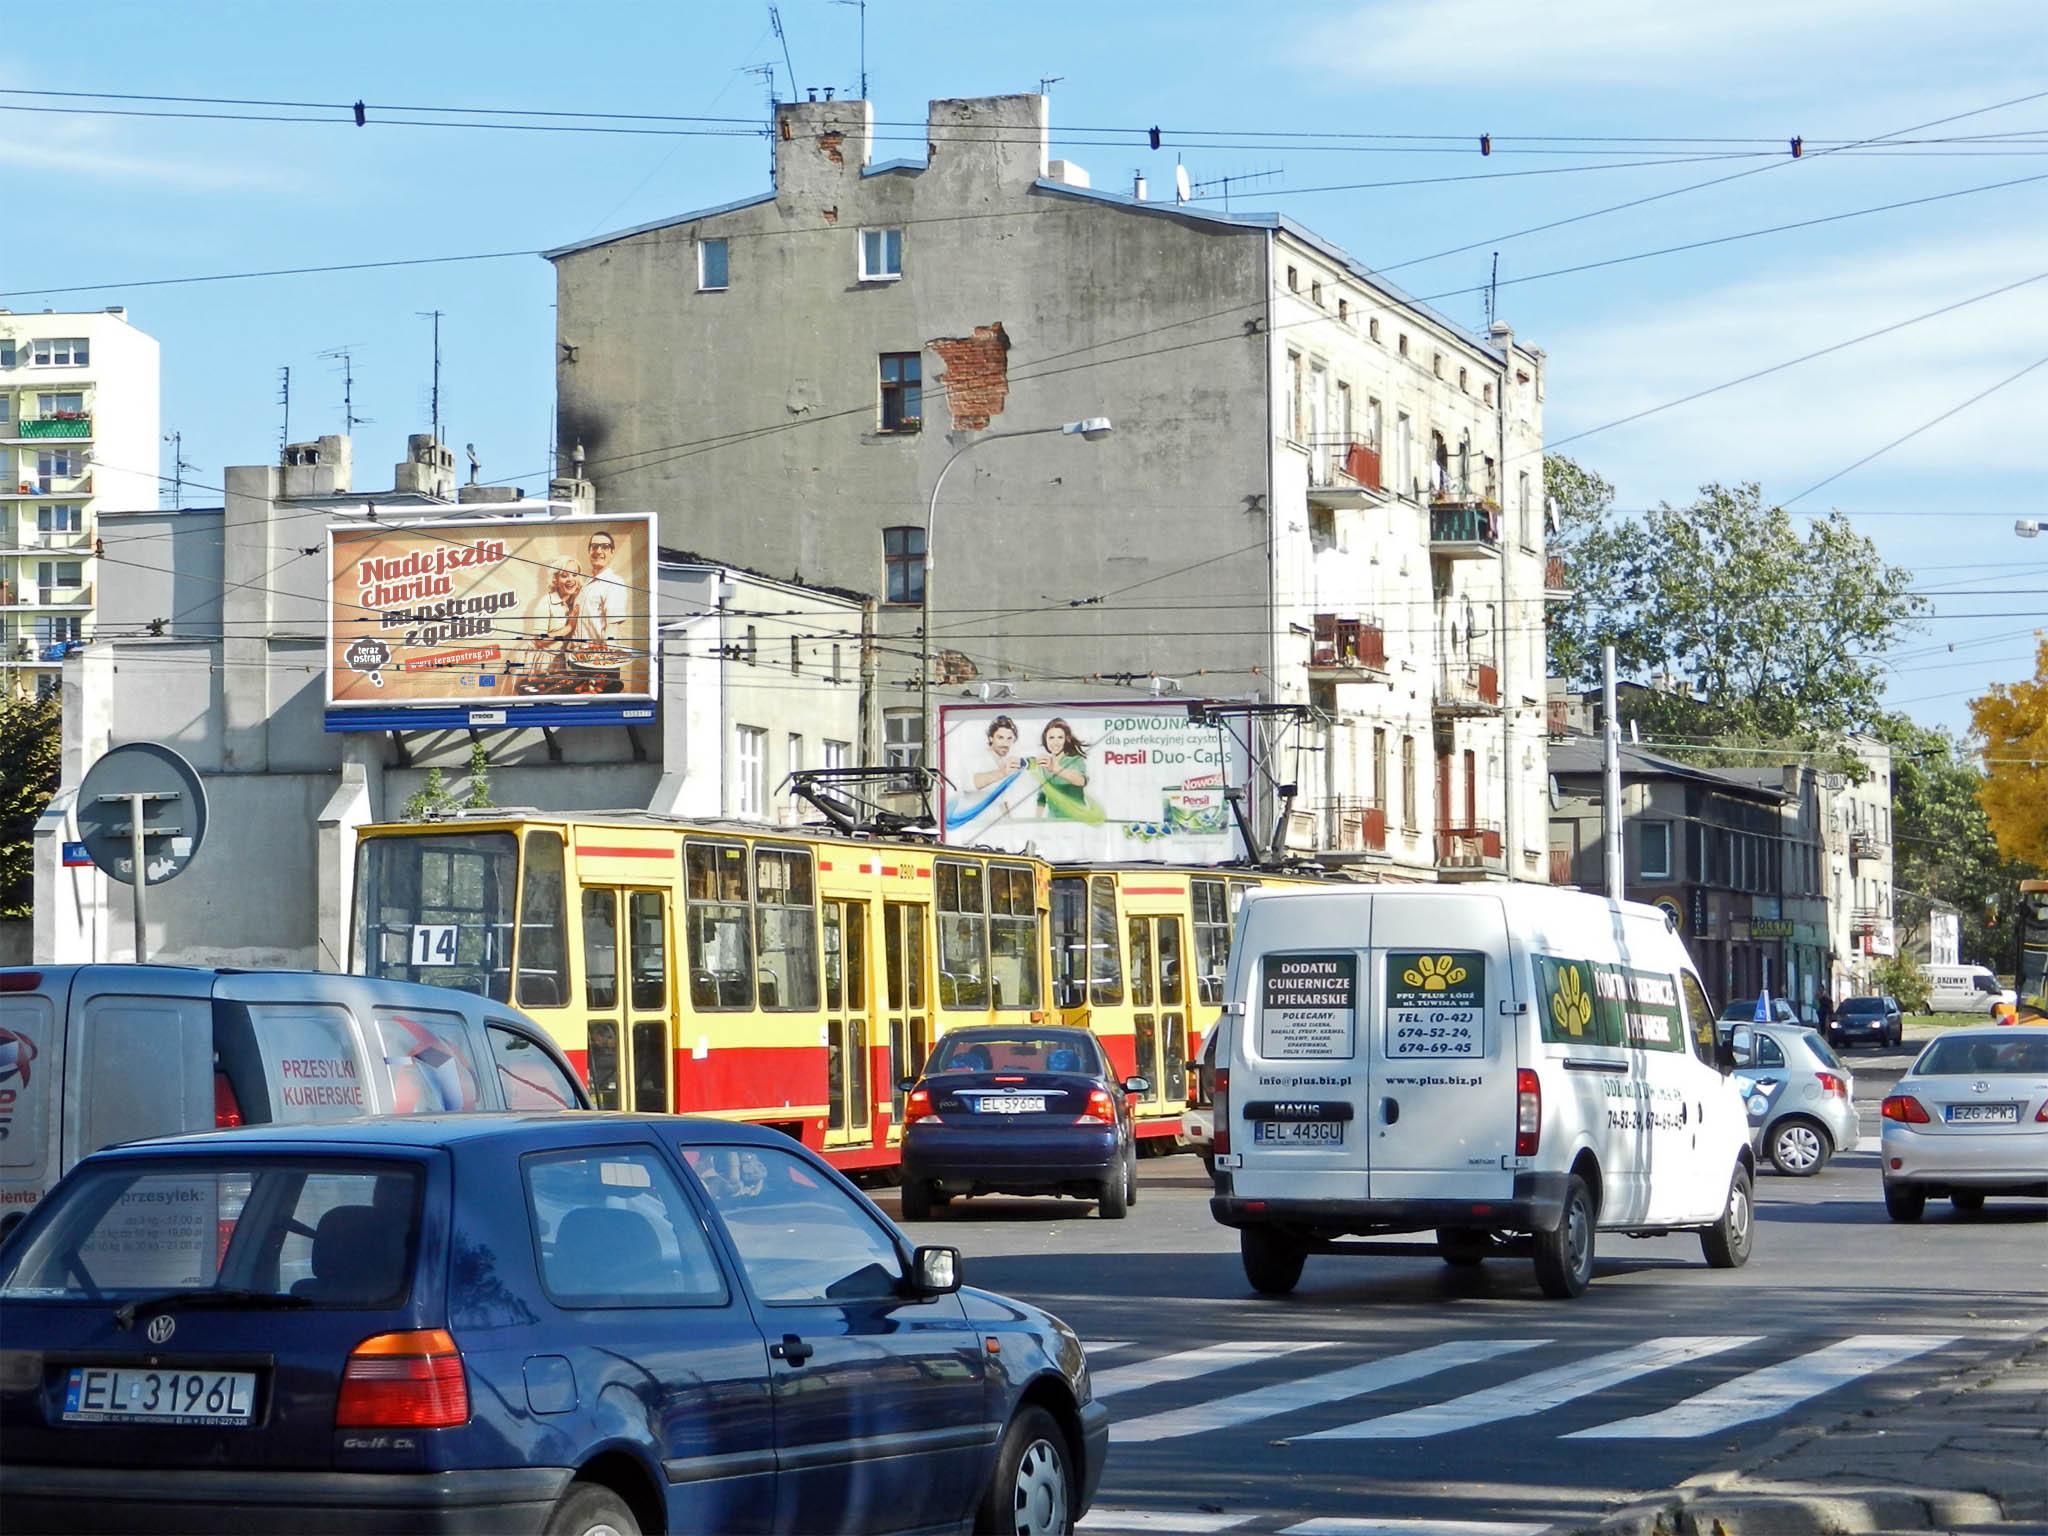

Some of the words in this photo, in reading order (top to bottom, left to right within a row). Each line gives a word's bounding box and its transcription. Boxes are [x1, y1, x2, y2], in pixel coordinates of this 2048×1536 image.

[359, 540, 505, 585] Nadejszła
[361, 575, 453, 608] chwila
[381, 607, 413, 629] na
[405, 629, 419, 646] z
[422, 612, 493, 646] grilla
[357, 646, 380, 655] teraz
[353, 653, 382, 665] pstrąg
[1104, 714, 1190, 731] PODWÓJNA
[1105, 735, 1121, 746] dla
[1123, 734, 1185, 748] perfekcyjnej
[1104, 749, 1147, 765] Persil
[1152, 748, 1233, 767] Duo-Caps
[1183, 794, 1210, 806] Persil
[419, 929, 455, 962] 14
[1281, 962, 1338, 975] DODATKI
[1405, 957, 1465, 985] PLUS
[1268, 978, 1351, 990] CUKIERNICZE
[1269, 994, 1274, 1005] I
[1277, 993, 1349, 1005] PIEKARSKIE
[1397, 1012, 1424, 1023] TEL.
[1429, 1012, 1473, 1023] (0-42)
[1397, 1027, 1472, 1039] 674-52-24,
[1398, 1042, 1473, 1053] 674-69-45
[281, 1058, 357, 1079] PRZESYŁKI
[1259, 1076, 1352, 1087] info@plus.biz.pl
[1385, 1075, 1483, 1087] www.plus.biz.pl
[283, 1086, 364, 1106] KURIERSKIE
[981, 1097, 1000, 1111] EL
[1003, 1097, 1044, 1110] 596GC
[1274, 1103, 1321, 1115] MAXUS
[1954, 1107, 1981, 1120] EZG
[1264, 1123, 1286, 1139] EL
[1292, 1123, 1340, 1139] 443GU
[83, 1371, 129, 1411] EL
[142, 1373, 246, 1415] 3196L
[343, 1437, 386, 1449] Golf
